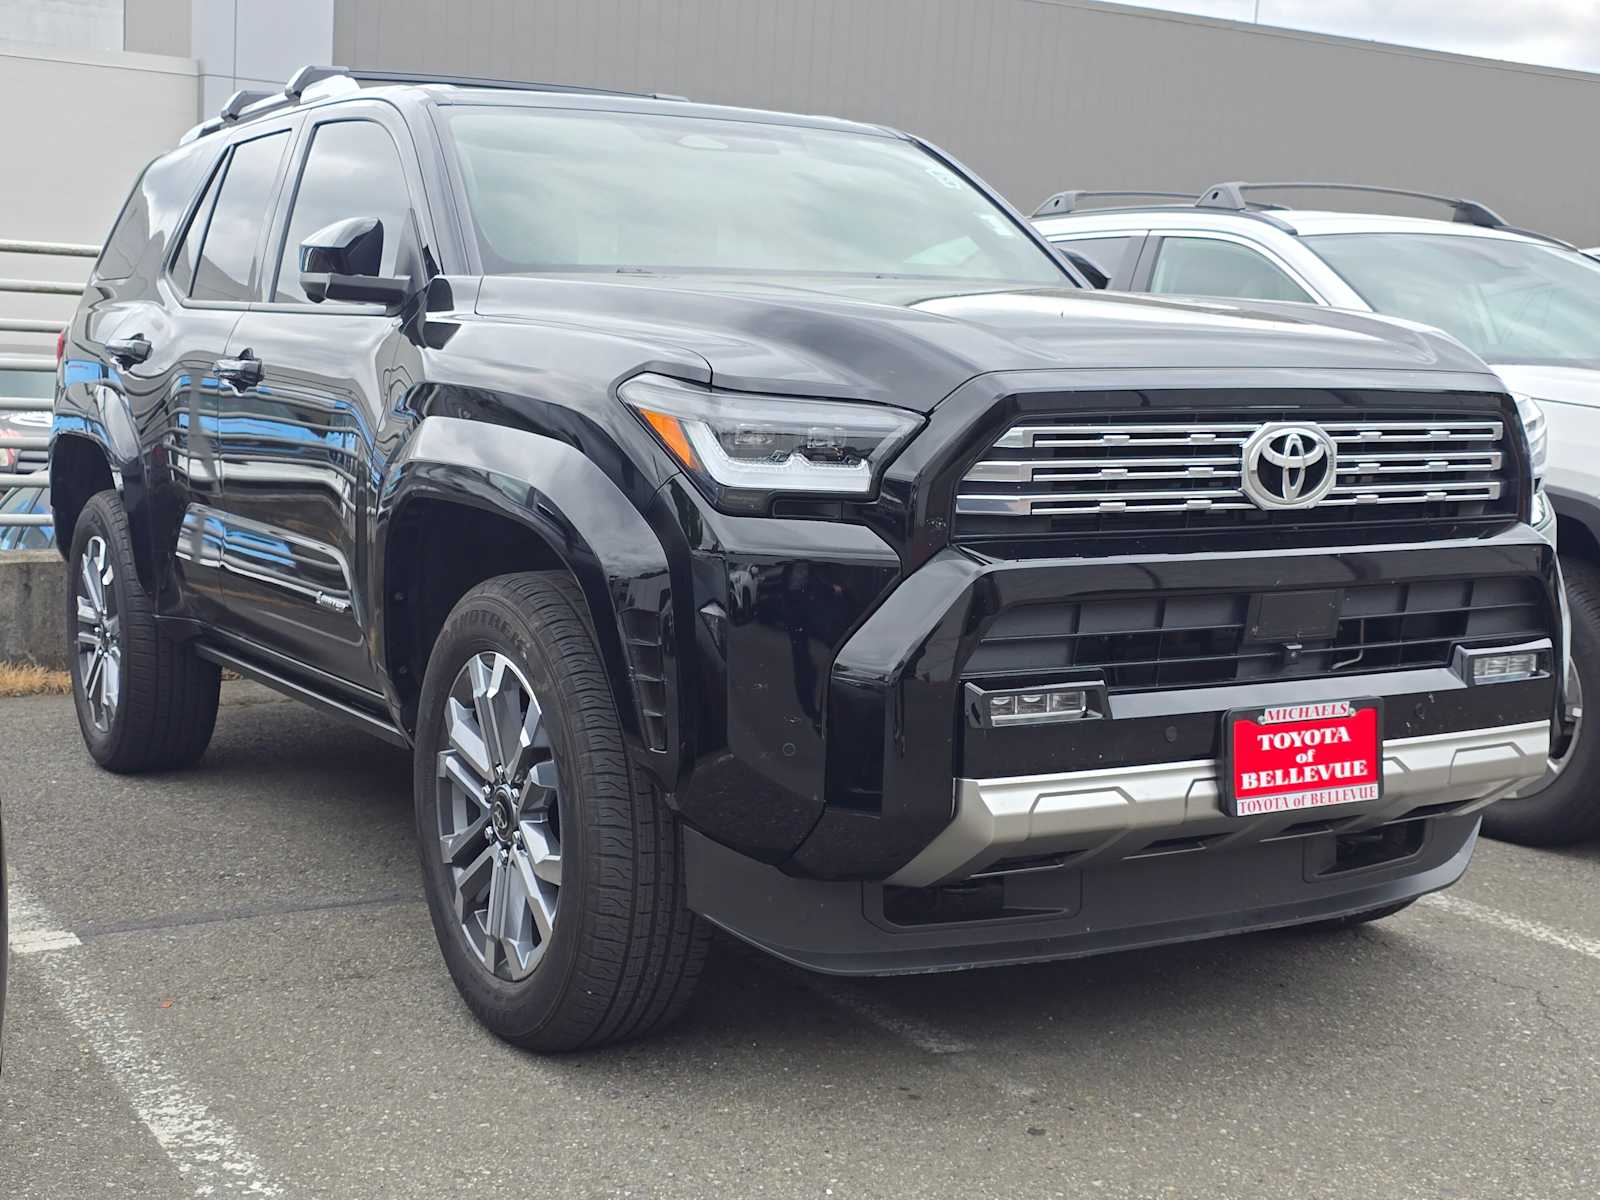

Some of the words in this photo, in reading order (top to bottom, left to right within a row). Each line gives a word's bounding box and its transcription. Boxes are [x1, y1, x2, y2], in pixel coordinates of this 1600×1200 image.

[1266, 703, 1348, 722] MICHAELS
[1257, 726, 1351, 751] TOYOTA
[1295, 749, 1316, 764] of
[1241, 759, 1368, 790] BELLEVUE
[1239, 798, 1289, 814] TOYOTA
[1293, 797, 1305, 807] of
[1311, 786, 1376, 804] BELLEVUE
